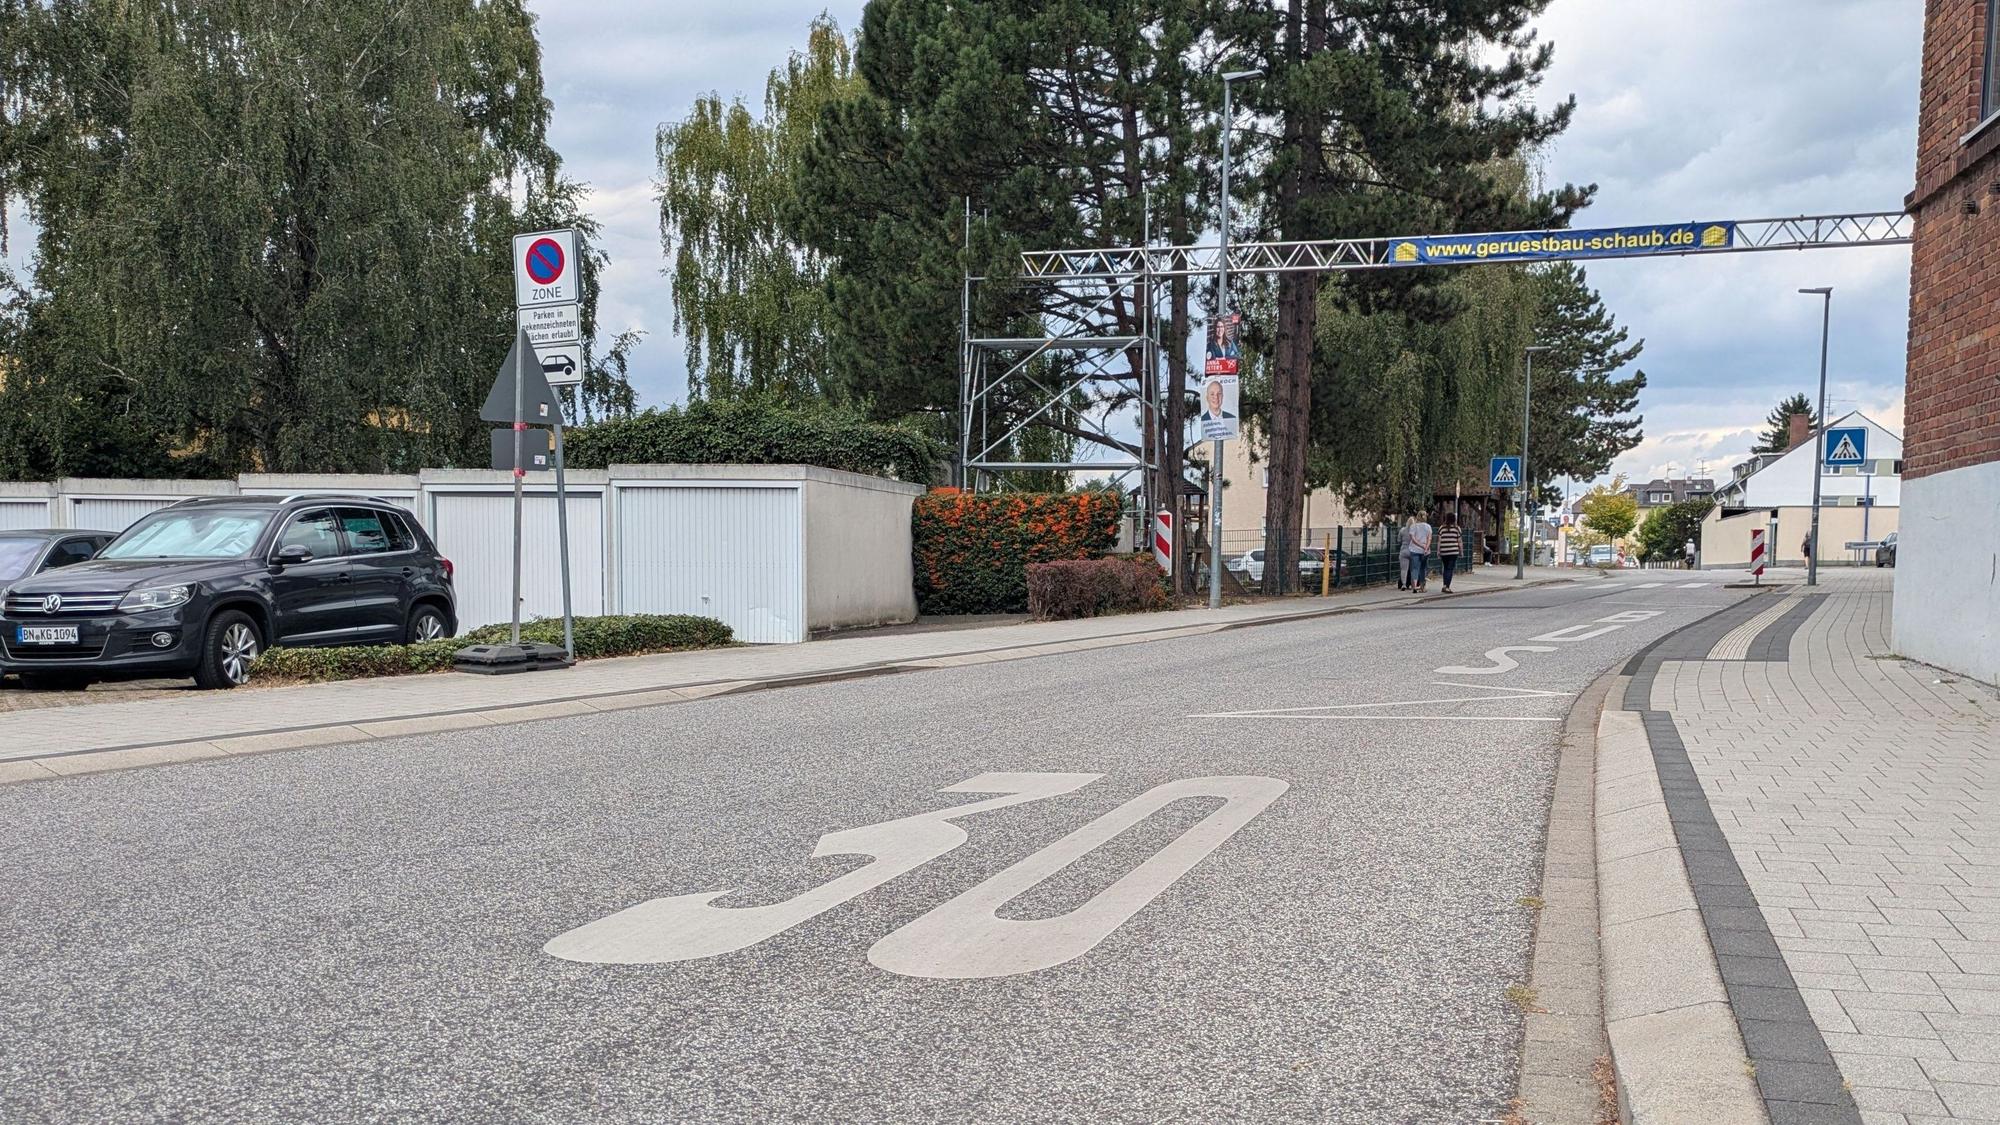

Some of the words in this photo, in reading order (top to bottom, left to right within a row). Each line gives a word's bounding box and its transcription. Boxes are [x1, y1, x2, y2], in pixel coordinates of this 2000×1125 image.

[1426, 230, 1694, 257] www.geruestbau-schaub.de
[532, 287, 562, 300] ZONE
[533, 310, 555, 320] Parken
[557, 309, 563, 318] in
[527, 330, 549, 341] ächen
[551, 329, 574, 339] erlaubt
[23, 629, 35, 640] BN
[40, 629, 52, 640] KG
[54, 628, 76, 640] 1094
[543, 773, 1289, 978] 30
